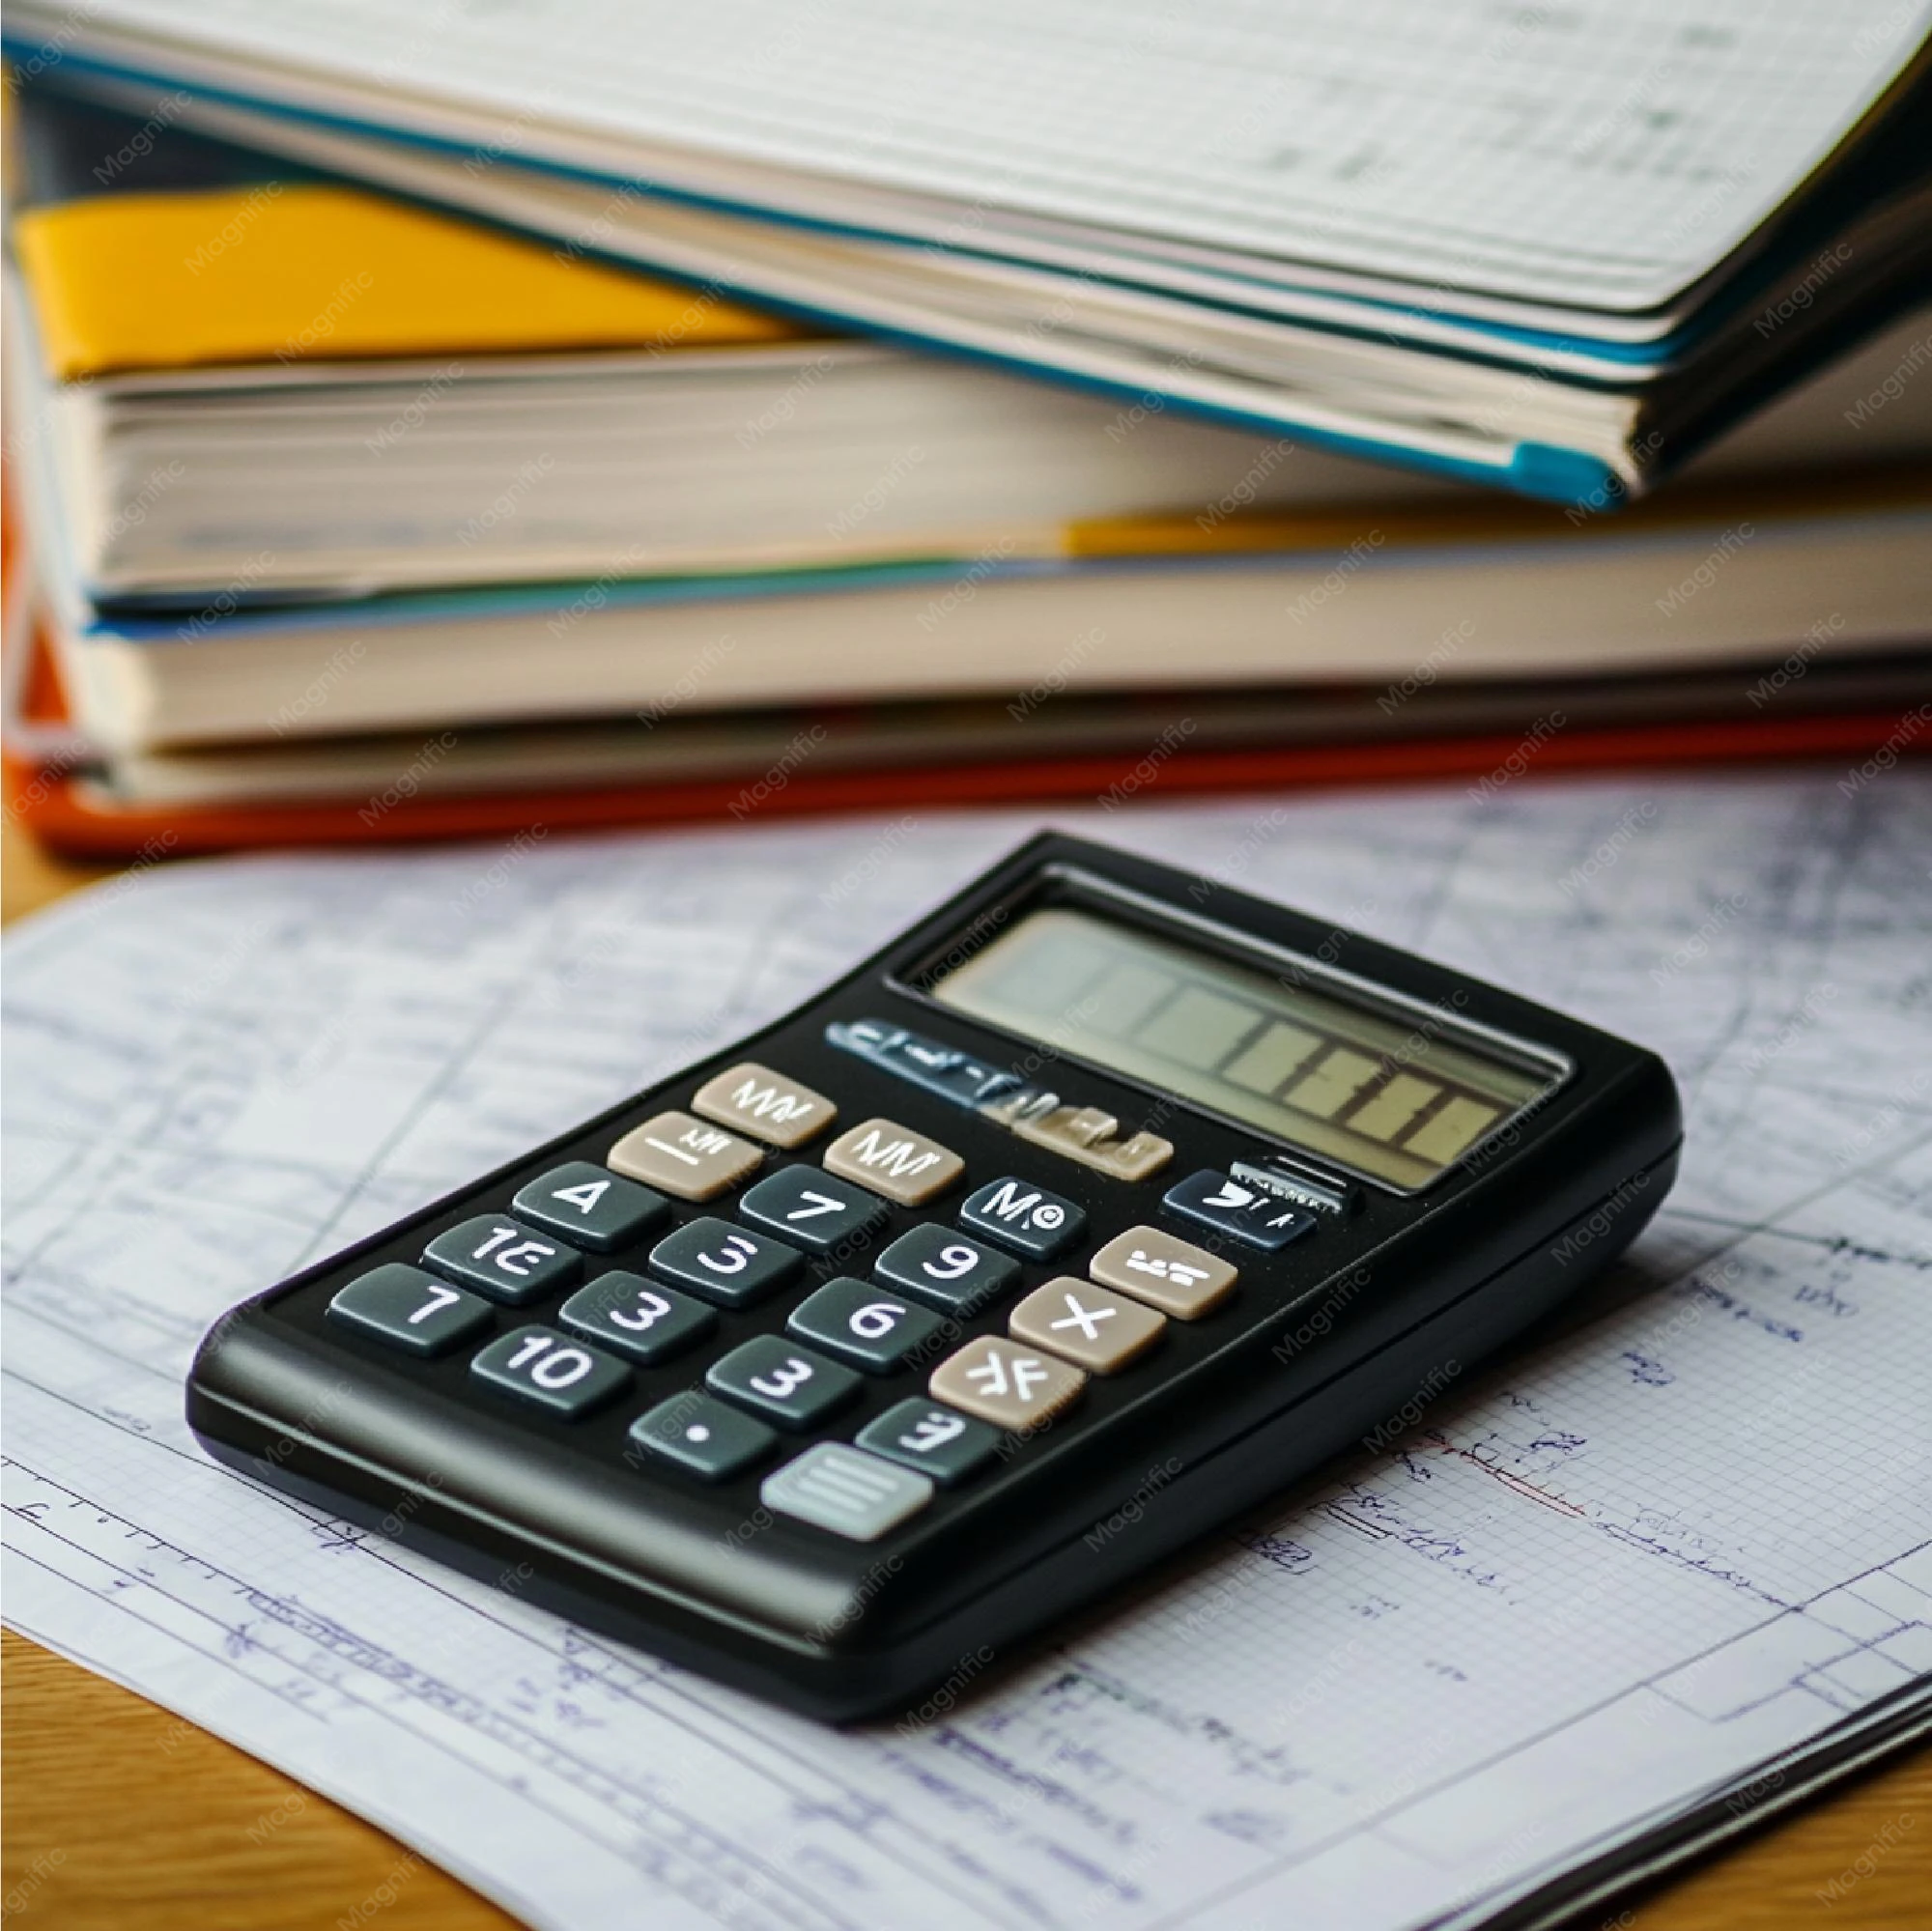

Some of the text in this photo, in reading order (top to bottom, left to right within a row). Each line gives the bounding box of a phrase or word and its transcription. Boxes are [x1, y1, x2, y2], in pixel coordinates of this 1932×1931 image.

[923, 1244, 979, 1280] 9
[610, 1292, 671, 1331] 3
[849, 1303, 906, 1339] 6
[507, 1336, 593, 1388] 10
[750, 1358, 813, 1399] 3
